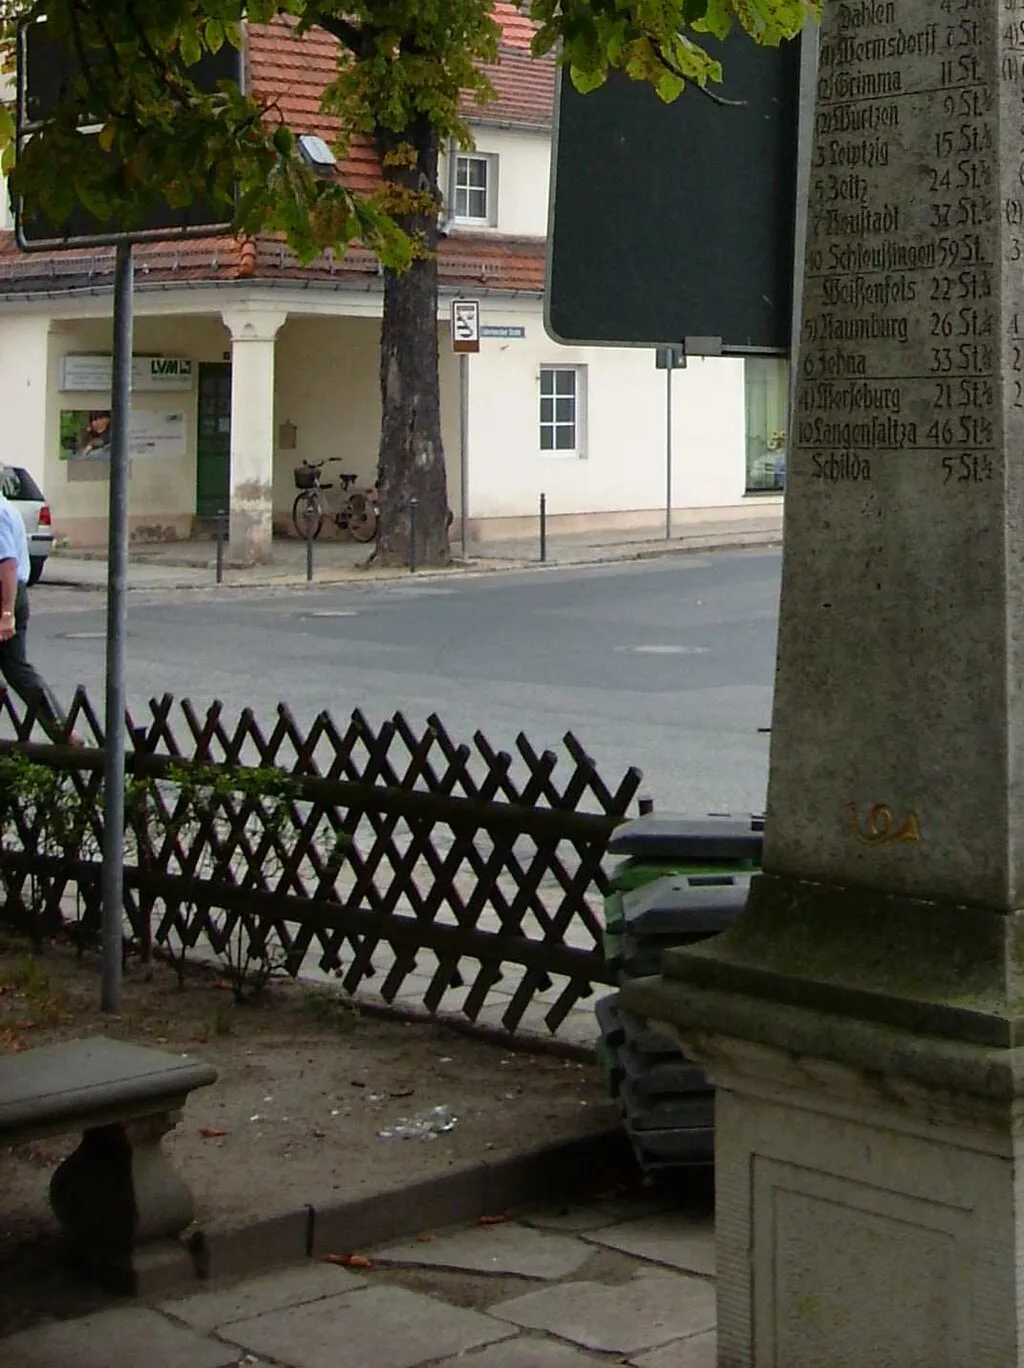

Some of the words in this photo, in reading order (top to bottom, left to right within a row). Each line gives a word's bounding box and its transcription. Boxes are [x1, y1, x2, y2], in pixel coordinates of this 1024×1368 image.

[834, 69, 903, 99] Grimma
[929, 311, 954, 338] 26
[151, 358, 178, 375] LVM
[929, 347, 953, 373] 33
[925, 419, 954, 446] 46
